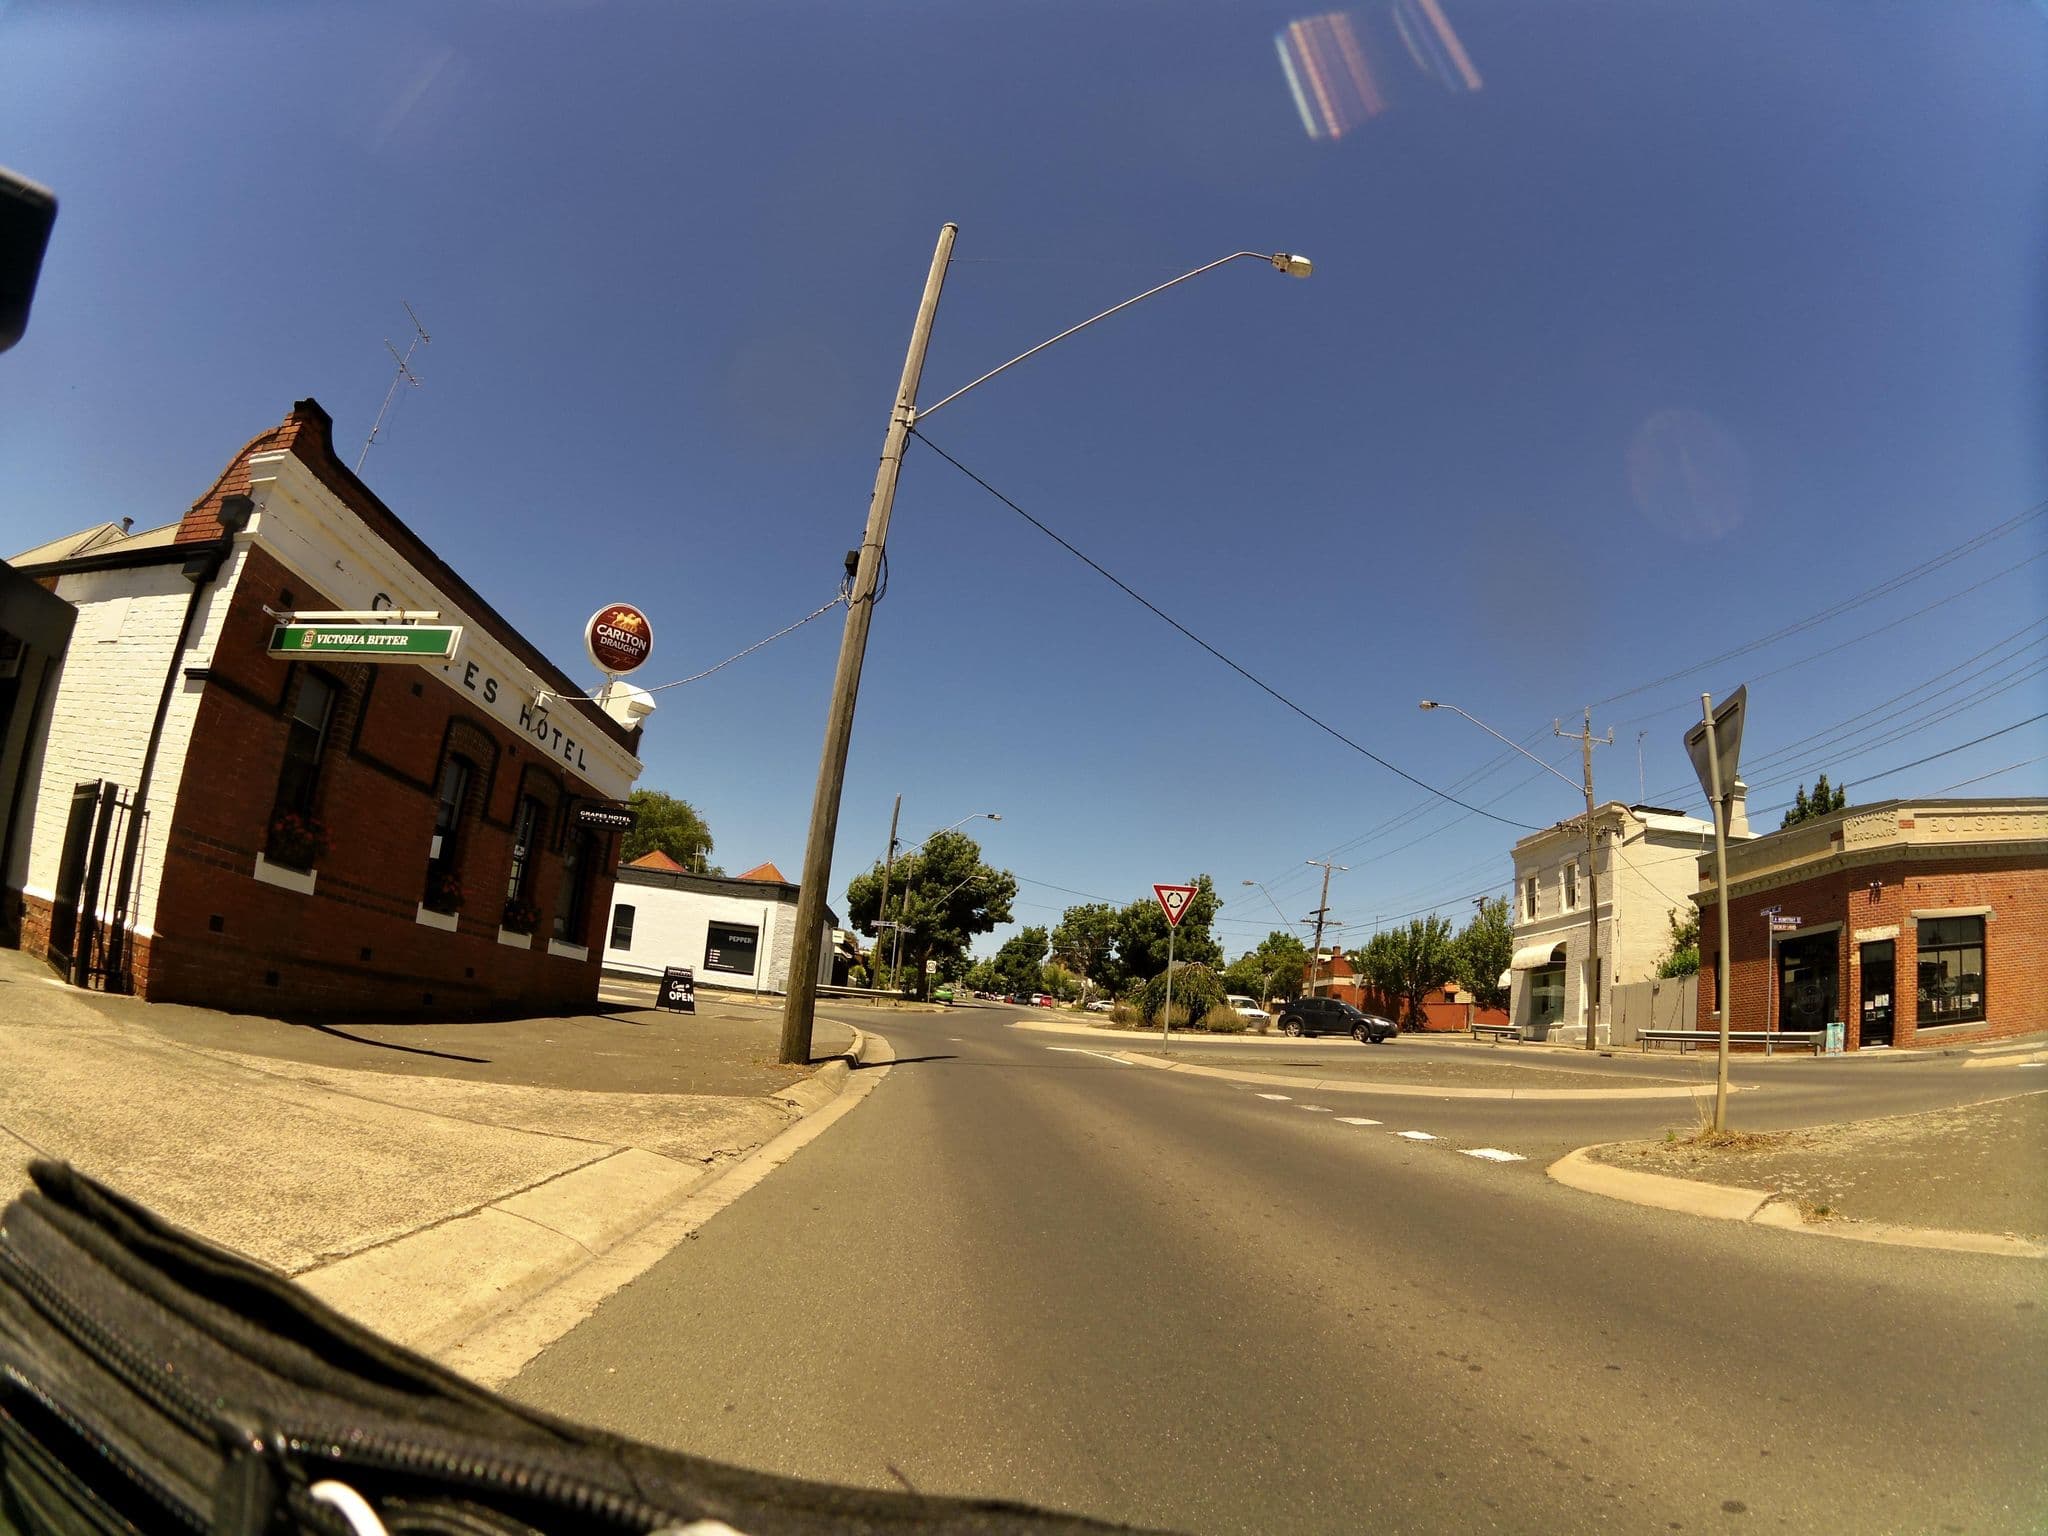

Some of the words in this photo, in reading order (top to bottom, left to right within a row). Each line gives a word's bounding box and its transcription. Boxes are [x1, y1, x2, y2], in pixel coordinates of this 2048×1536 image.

[317, 634, 365, 645] VICTORIA
[367, 635, 409, 646] BITTER
[596, 624, 647, 651] CARLTON
[600, 636, 640, 656] DRAUGHT
[519, 704, 587, 771] HOTEL
[580, 810, 607, 820] GRAPES
[608, 814, 631, 823] HOTEL
[669, 991, 694, 1002] OPEN
